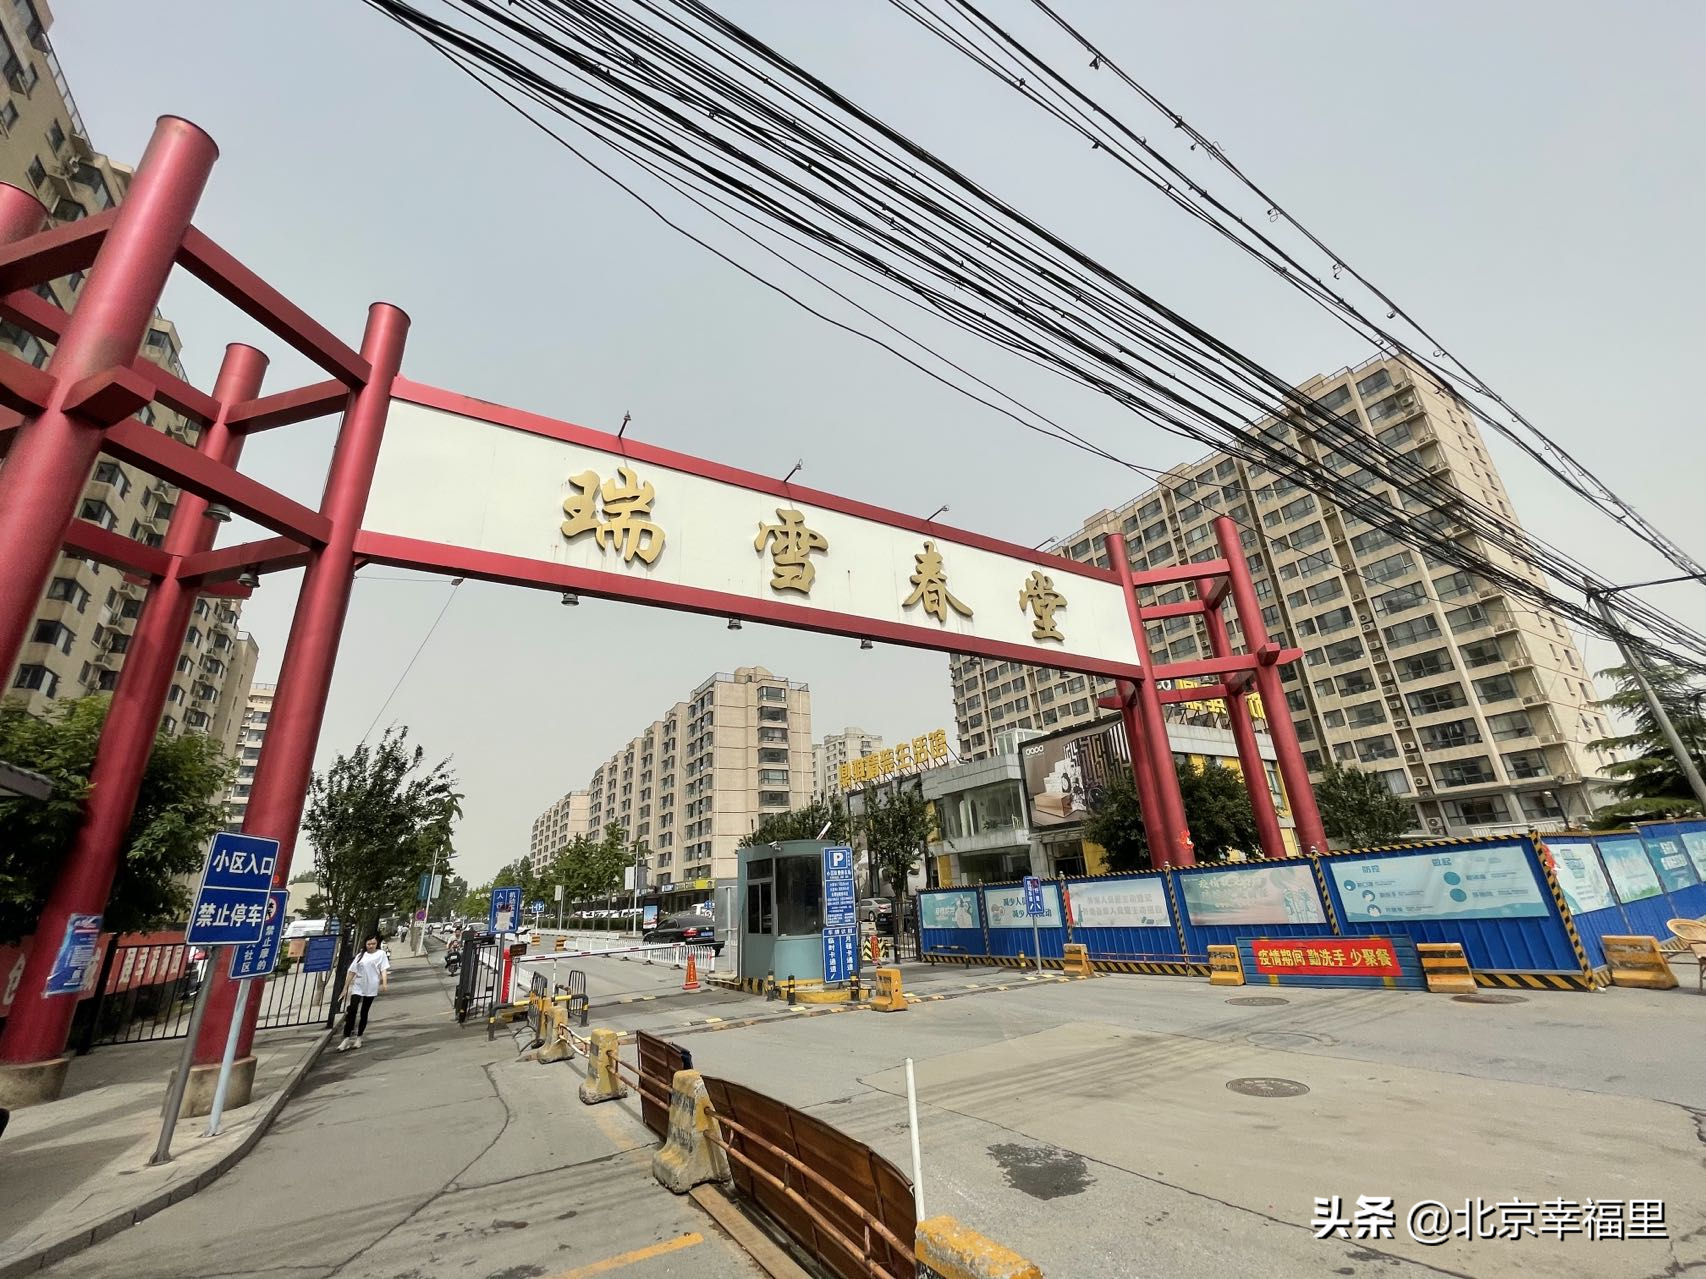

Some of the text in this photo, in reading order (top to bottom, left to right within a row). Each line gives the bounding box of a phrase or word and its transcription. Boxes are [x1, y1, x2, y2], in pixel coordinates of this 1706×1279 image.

[560, 466, 1068, 642] 瑞雪春堂
[213, 849, 275, 876] 小区入口
[833, 852, 844, 867] P
[195, 902, 264, 927] 禁止停车
[256, 925, 275, 971] 禁止摩的
[1258, 948, 1393, 967] 疫情期间 勤洗手 少聚餐
